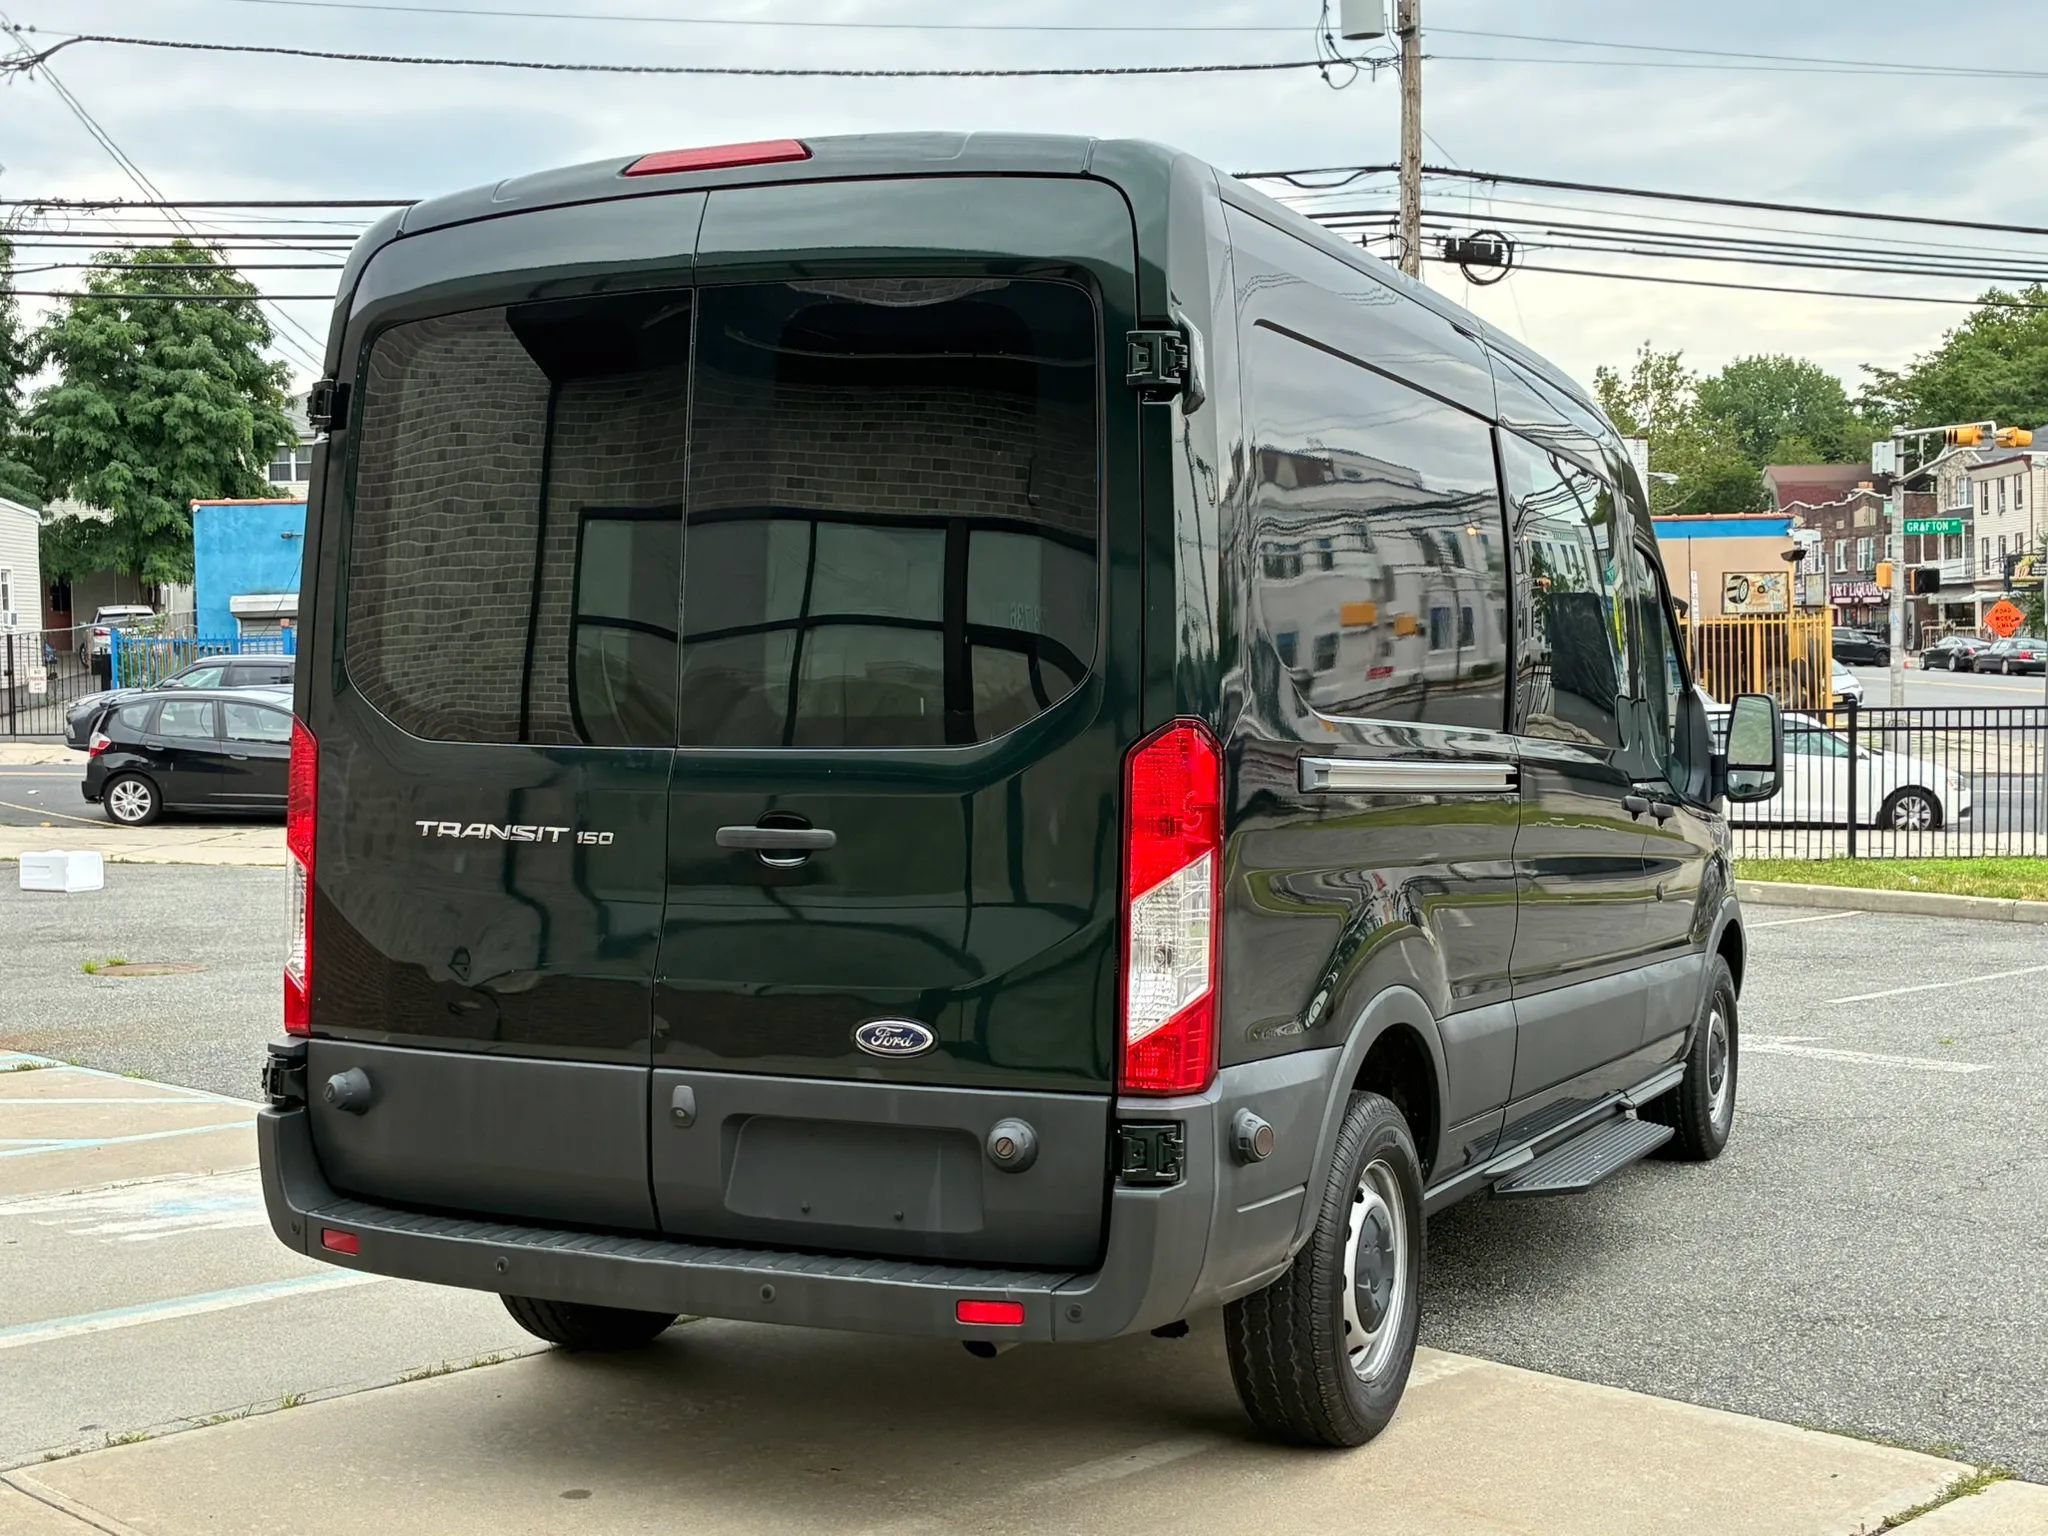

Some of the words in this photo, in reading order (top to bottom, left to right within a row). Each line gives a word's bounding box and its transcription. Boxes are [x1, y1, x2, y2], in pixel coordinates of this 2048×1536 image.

[1906, 520, 1949, 533] GRAFTON
[1849, 581, 1883, 598] LIQUORS
[415, 820, 571, 843] TRANSIT
[576, 831, 615, 845] 150
[871, 1026, 914, 1047] Ford
